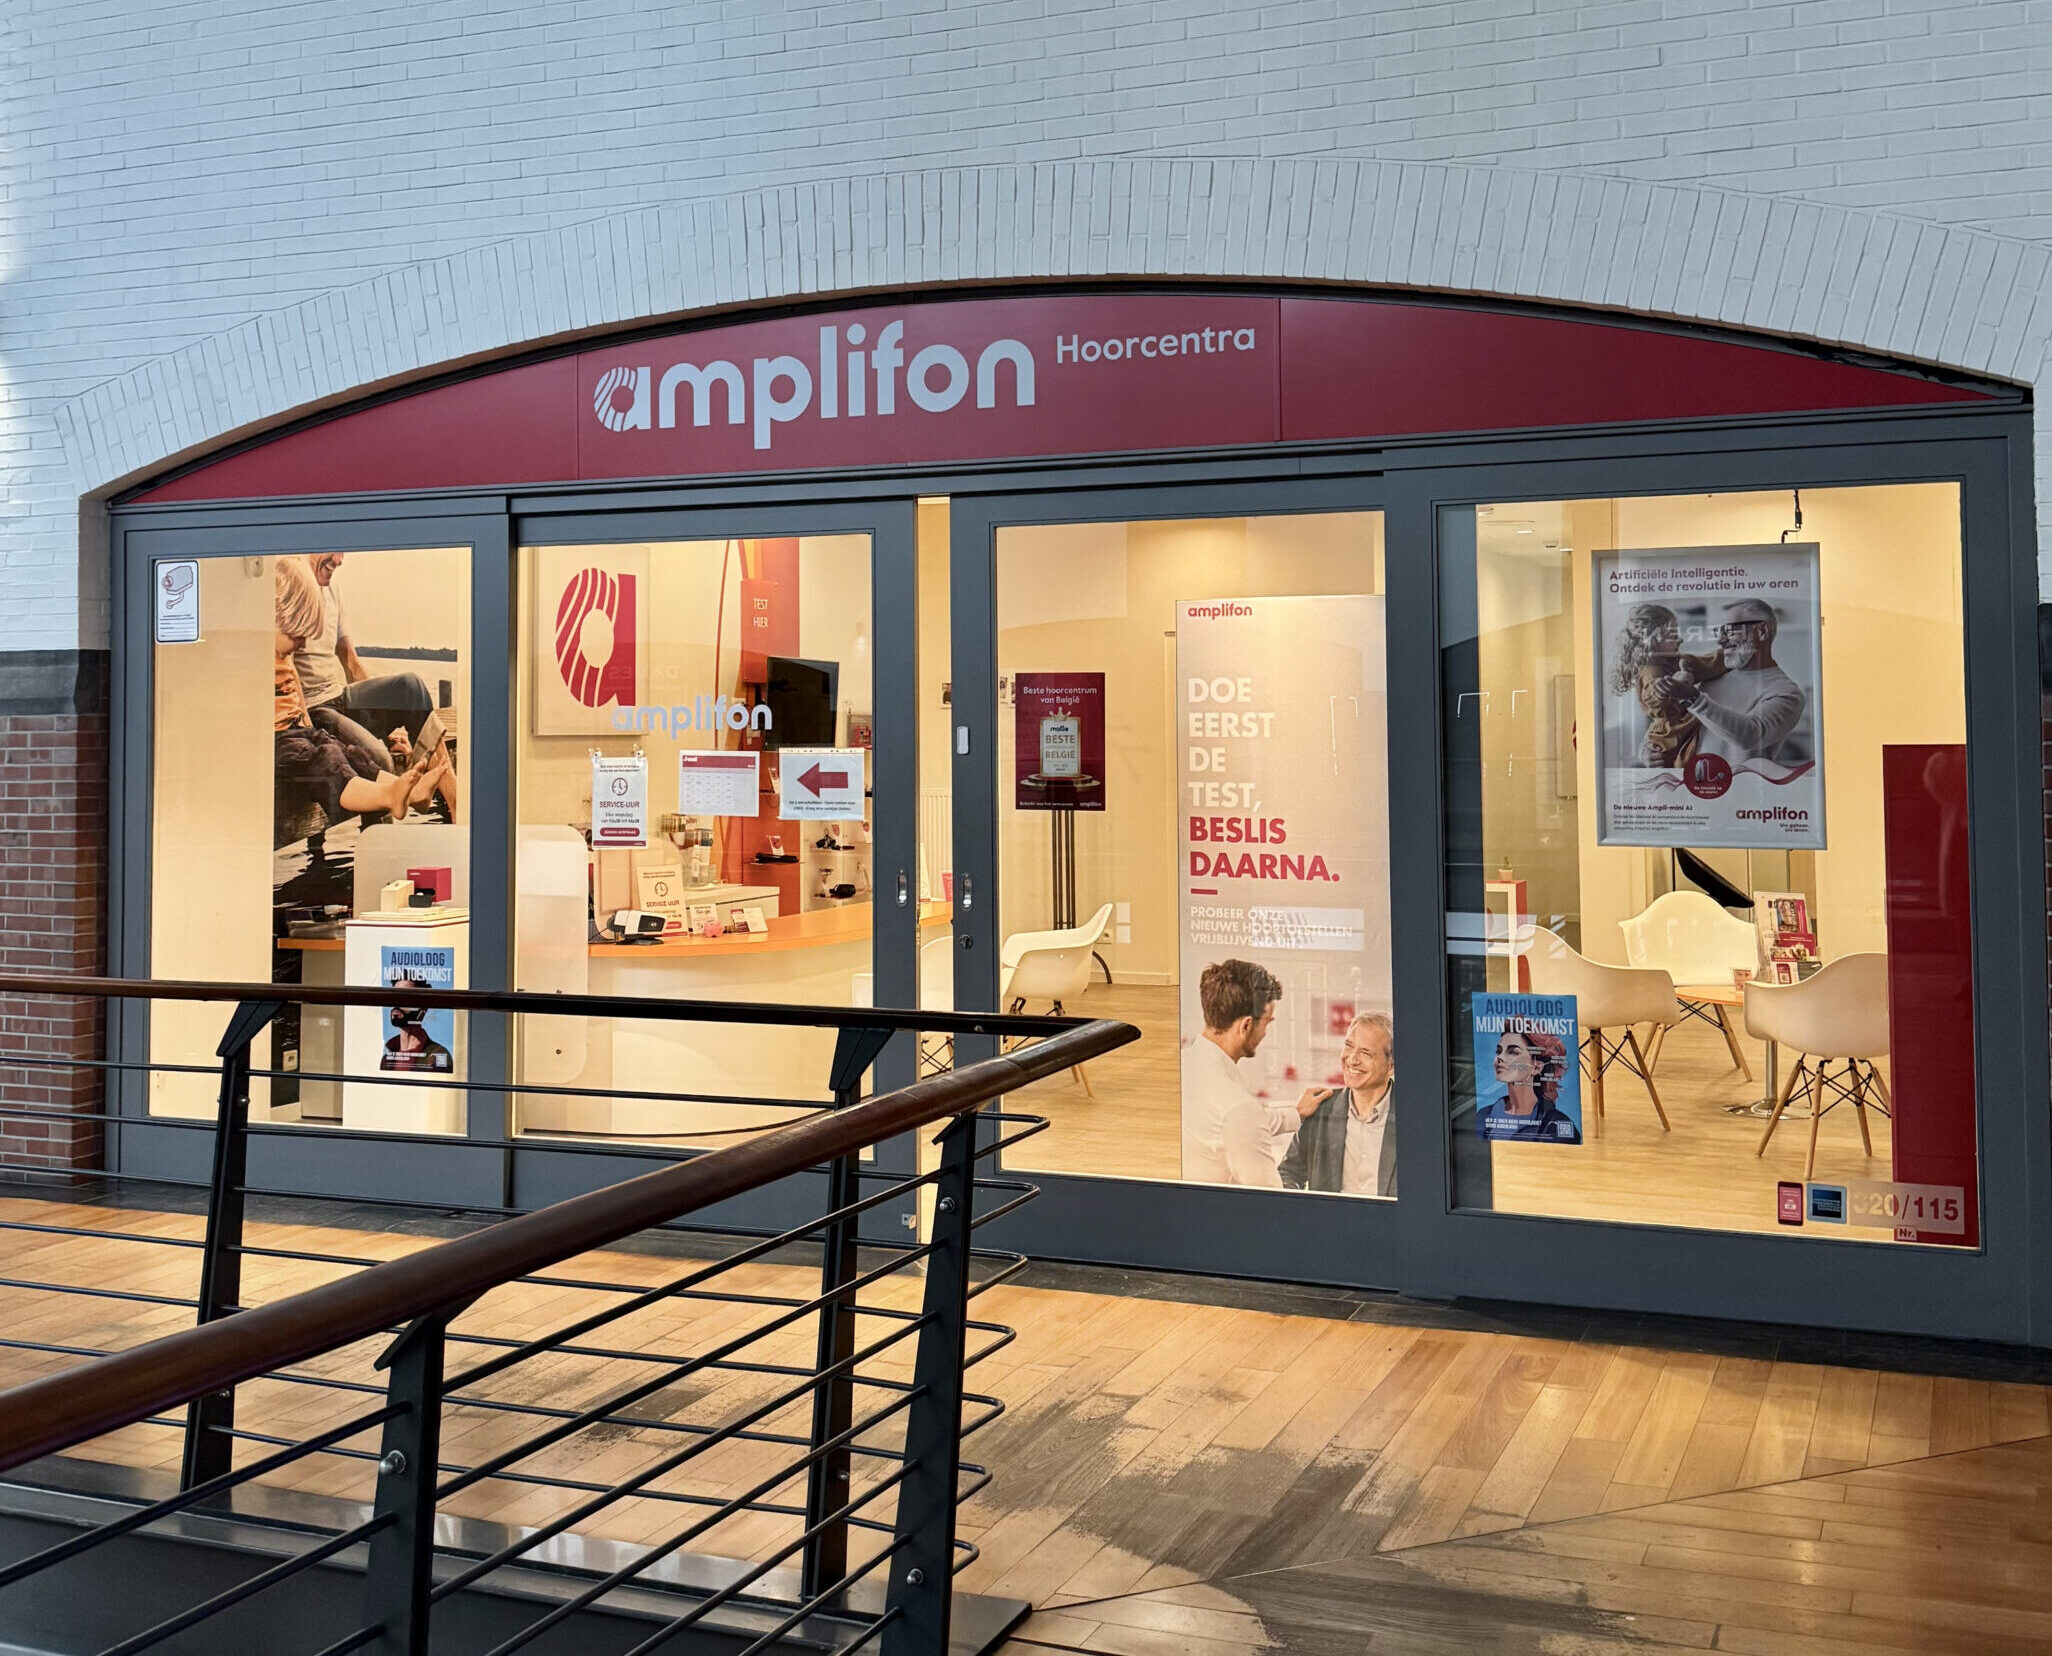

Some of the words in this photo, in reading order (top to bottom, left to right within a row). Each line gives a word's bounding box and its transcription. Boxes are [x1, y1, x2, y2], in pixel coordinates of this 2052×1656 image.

[593, 319, 1036, 450] amplifon
[1056, 326, 1256, 364] Hoorcentra
[1609, 568, 1668, 581] Artificiële
[1671, 566, 1748, 582] Intelligentie.
[1609, 582, 1655, 593] Ontdek
[1658, 581, 1673, 592] de
[1676, 580, 1731, 592] revolutie
[1733, 579, 1745, 590] in
[1749, 580, 1766, 590] uw
[753, 598, 769, 610] TEST
[1187, 603, 1253, 620] amplifon
[753, 616, 769, 628] HIER
[1023, 687, 1045, 695] Beste
[1046, 686, 1097, 695] hoorcentrum
[1187, 677, 1253, 704] DOE
[611, 694, 773, 741] amplifon
[1188, 712, 1276, 738] EERST
[1045, 735, 1076, 744] BESTE
[1188, 747, 1227, 773] DE
[1187, 781, 1262, 812] TEST,
[1735, 806, 1809, 823] amplifon
[1189, 816, 1287, 845] BESLIS
[1190, 851, 1341, 882] DAARNA.
[1190, 906, 1244, 919] PROBEER
[1190, 920, 1239, 932] NIEUWE
[1190, 933, 1275, 948] VRIJBLIJVEND
[391, 952, 445, 966] AUDIOLOOG
[383, 966, 404, 980] MIJN
[406, 967, 452, 982] TOEKOMST
[1485, 998, 1564, 1017] AUDIOLOOG
[1475, 1016, 1505, 1033] MIJN
[1507, 1017, 1575, 1036] TOEKOMST
[1899, 1228, 1915, 1238] Nr.
